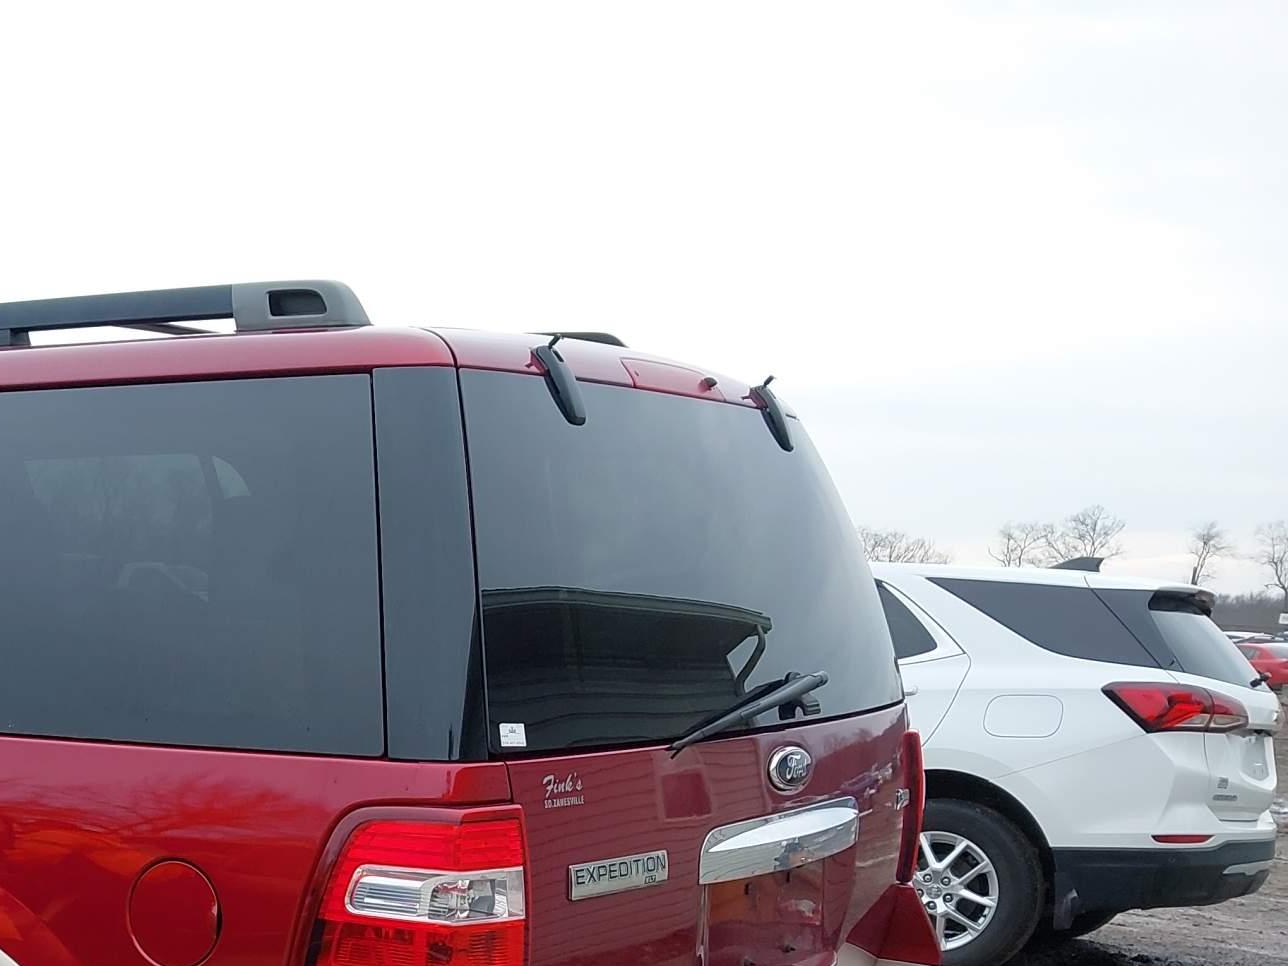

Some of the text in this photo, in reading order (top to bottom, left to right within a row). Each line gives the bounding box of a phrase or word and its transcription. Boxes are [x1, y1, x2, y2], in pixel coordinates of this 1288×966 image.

[786, 754, 808, 780] Ford
[542, 772, 583, 798] Fink's
[575, 854, 666, 886] EXPEDITION
